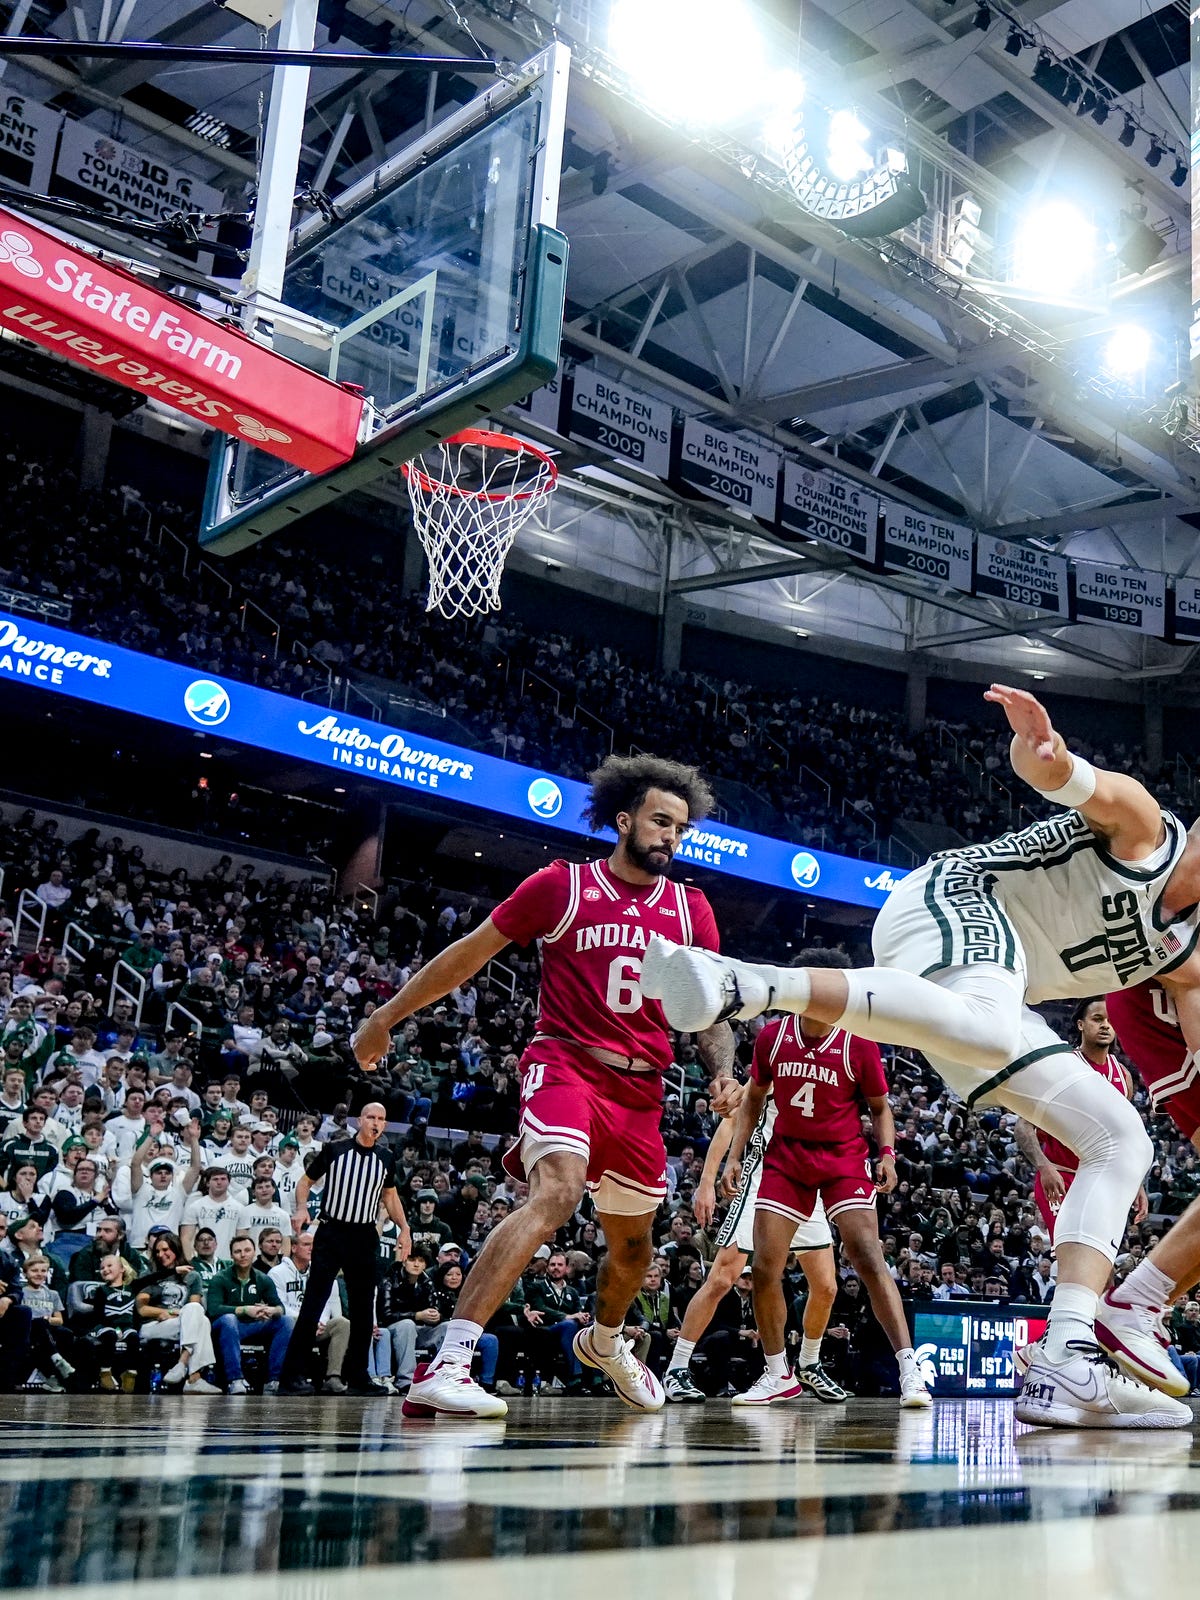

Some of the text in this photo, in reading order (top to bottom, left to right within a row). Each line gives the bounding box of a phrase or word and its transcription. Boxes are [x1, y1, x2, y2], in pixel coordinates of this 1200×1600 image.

[82, 151, 204, 214] TOURNAMENT
[351, 266, 421, 310] BIG TN
[596, 383, 652, 420] BIG TEN
[576, 393, 669, 444] CHAMPIONS
[597, 427, 643, 458] 2009
[704, 434, 759, 467] BIG TEN
[686, 443, 775, 490] CHAMPIONS
[710, 474, 750, 502] 2001
[796, 484, 868, 520] TOURNAMENT
[794, 495, 868, 534] CHAMPIONS
[904, 515, 955, 542] BIG TEN
[806, 516, 852, 548] 2000
[888, 526, 970, 561] CHAMPIONS
[906, 552, 947, 576] 2000
[988, 553, 1058, 580] TOURNAMENT
[988, 564, 1059, 592] CHAMPIONS
[1004, 583, 1042, 607] 1999
[1079, 583, 1164, 608] CHAMPIONS
[1095, 572, 1147, 592] BIG TEN
[1103, 606, 1138, 624] 1999
[332, 746, 439, 788] INSURANCE
[1059, 934, 1112, 973] 0
[606, 955, 643, 1014] 6
[777, 1061, 838, 1087] INDIANA
[790, 1082, 816, 1118] 4
[380, 1244, 390, 1258] 11
[960, 1316, 1028, 1346] 1 19:44 0
[981, 1357, 1002, 1376] 1ST
[968, 1378, 1012, 1388] POSS POSS
